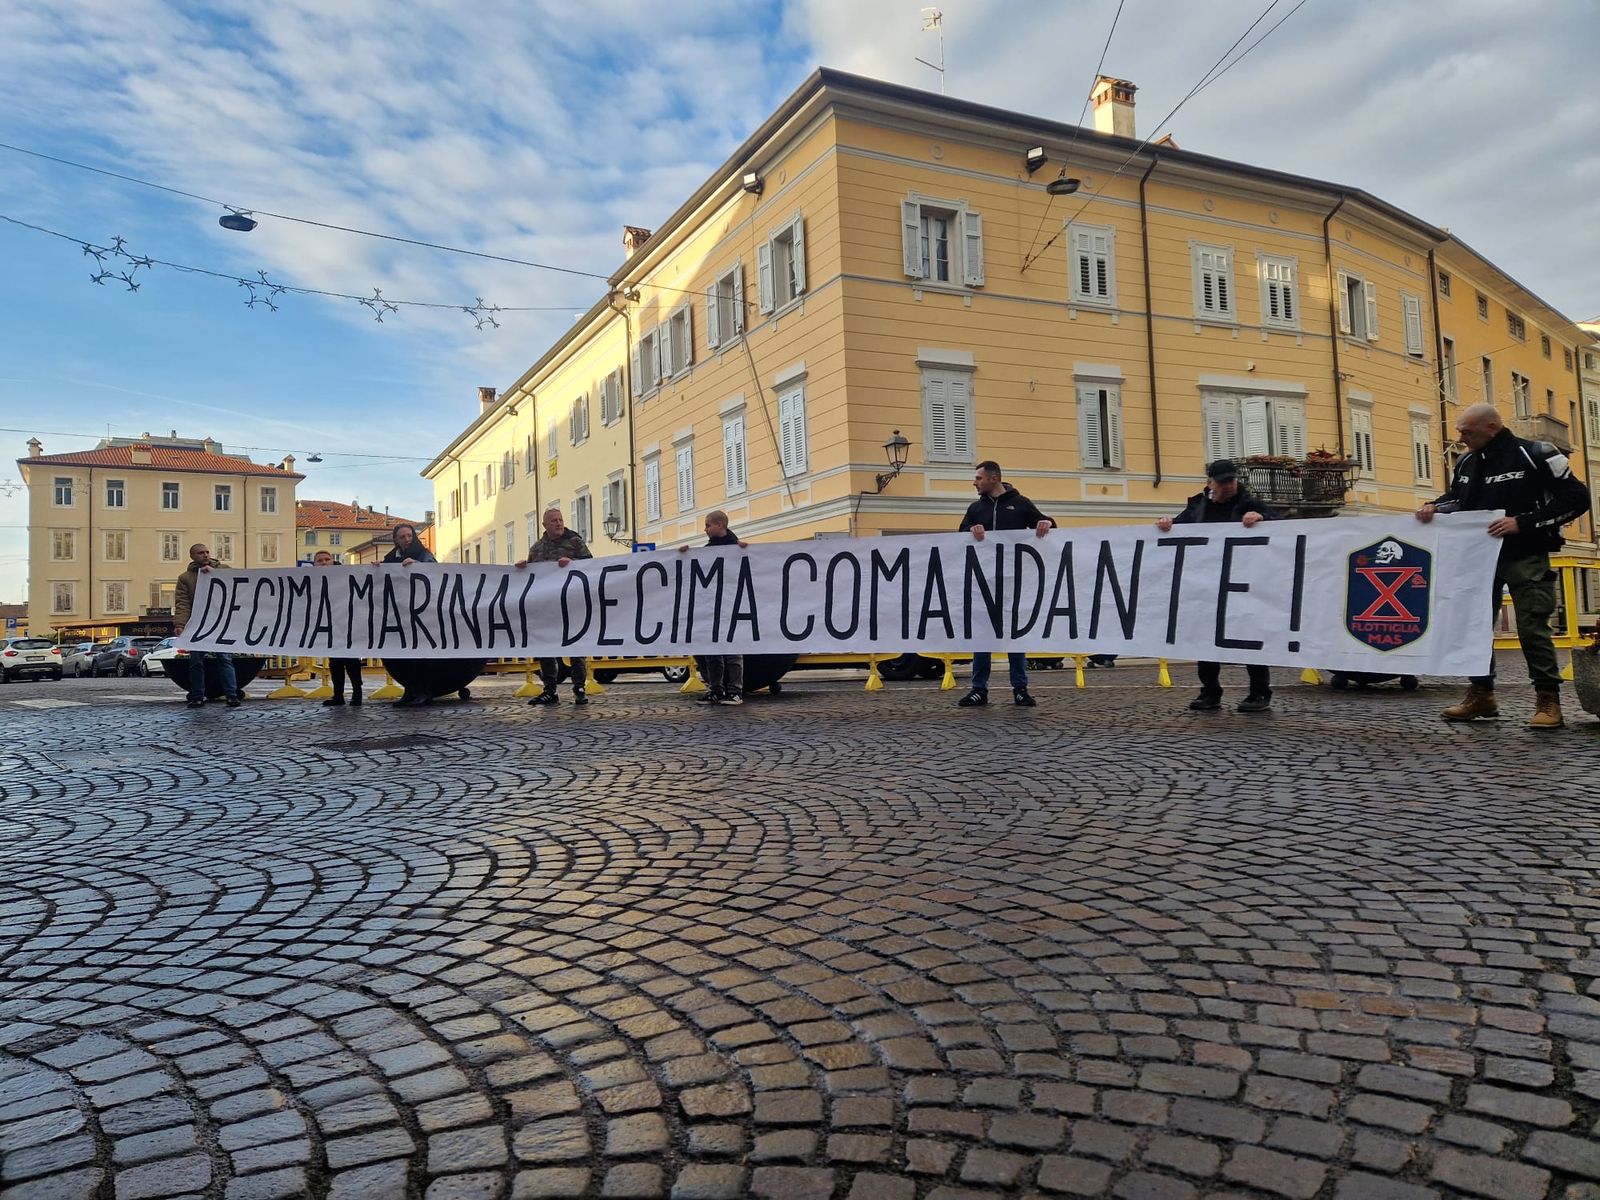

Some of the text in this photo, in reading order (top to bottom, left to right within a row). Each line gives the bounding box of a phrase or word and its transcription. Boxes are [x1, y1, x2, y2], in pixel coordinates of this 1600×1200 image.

[190, 575, 333, 649] DECIMA
[347, 572, 536, 650] MARINAI
[560, 556, 761, 647] DECIMA
[1351, 622, 1421, 634] FLOTTIGLIA
[1367, 633, 1403, 645] MAS
